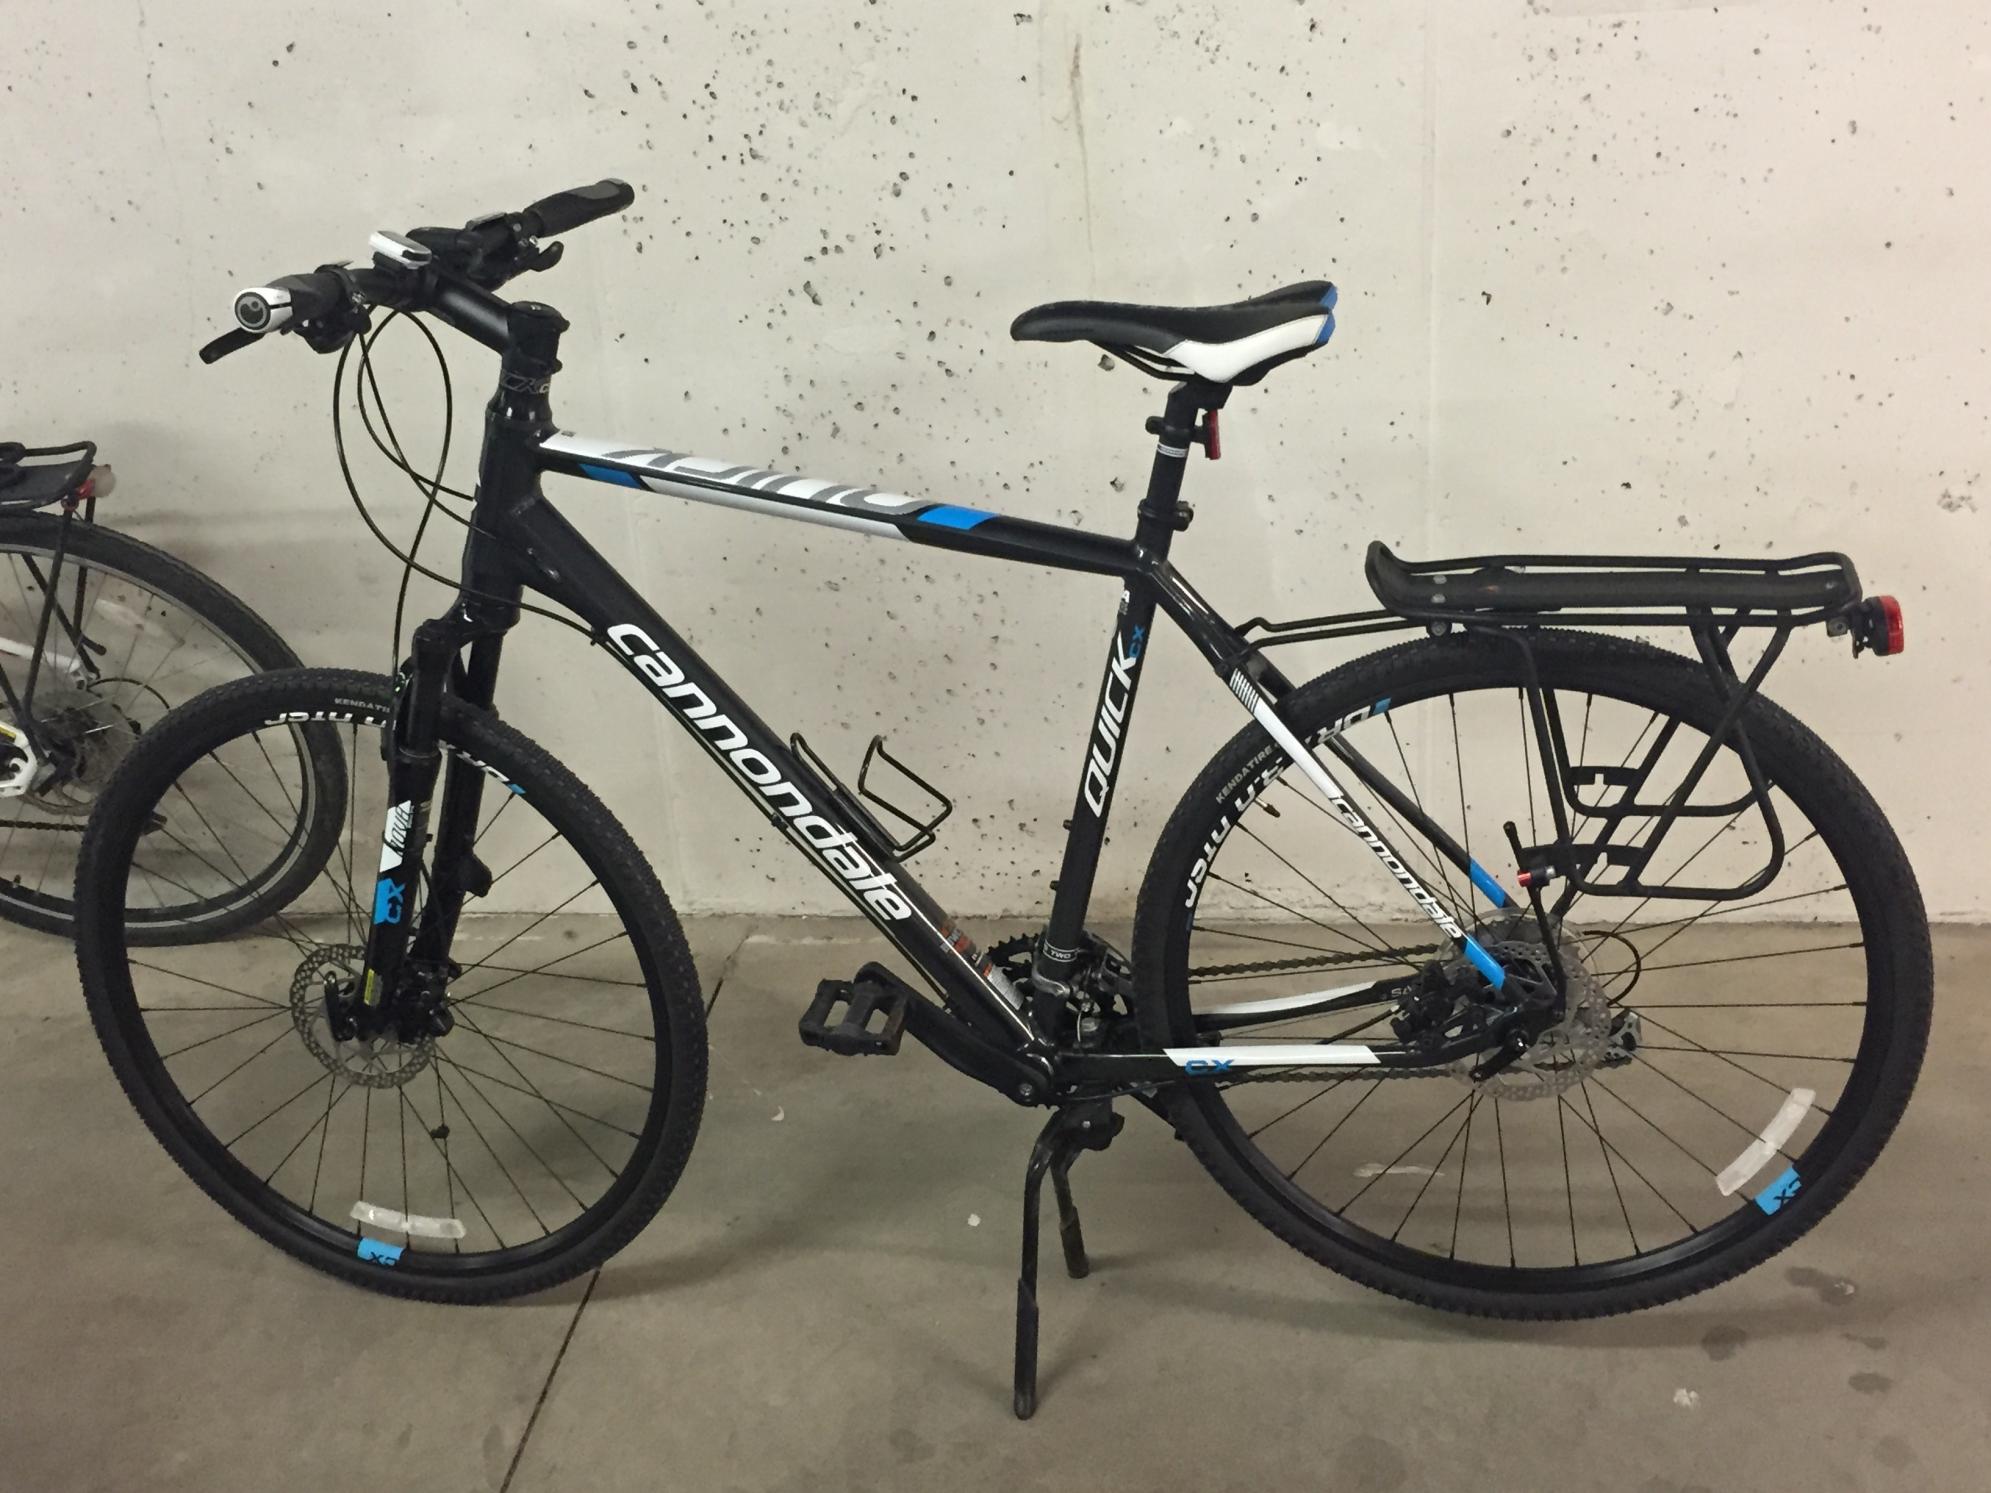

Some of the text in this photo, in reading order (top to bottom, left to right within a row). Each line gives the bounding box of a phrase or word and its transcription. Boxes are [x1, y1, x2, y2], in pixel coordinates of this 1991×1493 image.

[607, 623, 912, 921] cannondale
[1084, 631, 1137, 818] QUICK
[385, 877, 406, 925] CX
[1330, 797, 1462, 939] cannondale
[1184, 1059, 1235, 1077] CX
